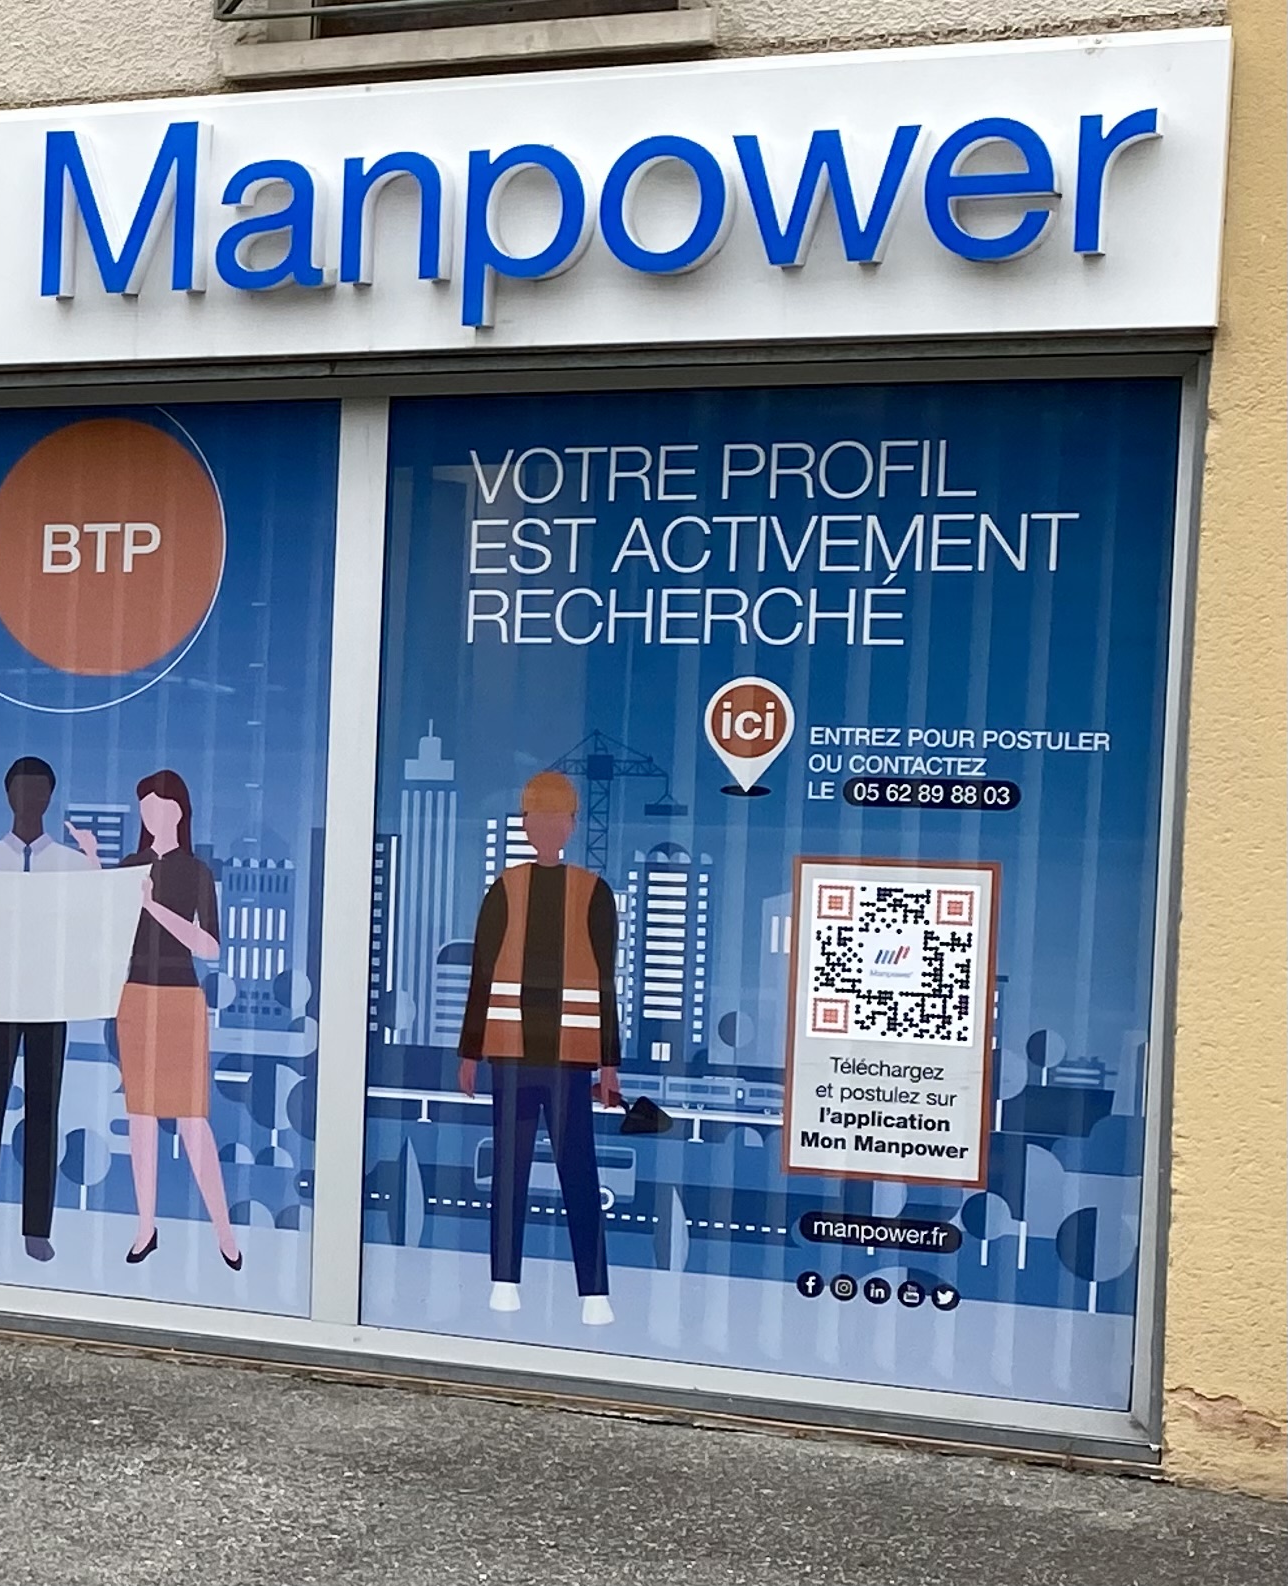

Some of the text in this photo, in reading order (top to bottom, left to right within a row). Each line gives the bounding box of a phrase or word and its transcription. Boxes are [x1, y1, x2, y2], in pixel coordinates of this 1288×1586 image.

[40, 108, 1160, 328] Manpower
[469, 439, 977, 504] VOTRE PROFIL
[42, 522, 162, 574] BTP
[469, 512, 1080, 575] EST ACTIVEMENT
[466, 572, 907, 646] RECHERCHÉ
[721, 701, 775, 741] ici
[809, 726, 1111, 752] ENTREZ POUR POSTULER
[808, 754, 988, 777] OU CONTACTEZ
[807, 781, 1011, 806] LE 05 62 89 88 03
[829, 1056, 945, 1083] Téléchargez
[815, 1083, 958, 1107] et postulez sur
[819, 1106, 951, 1132] l'application
[800, 1130, 969, 1159] Mon Manpower
[813, 1220, 949, 1247] manpower.fr
